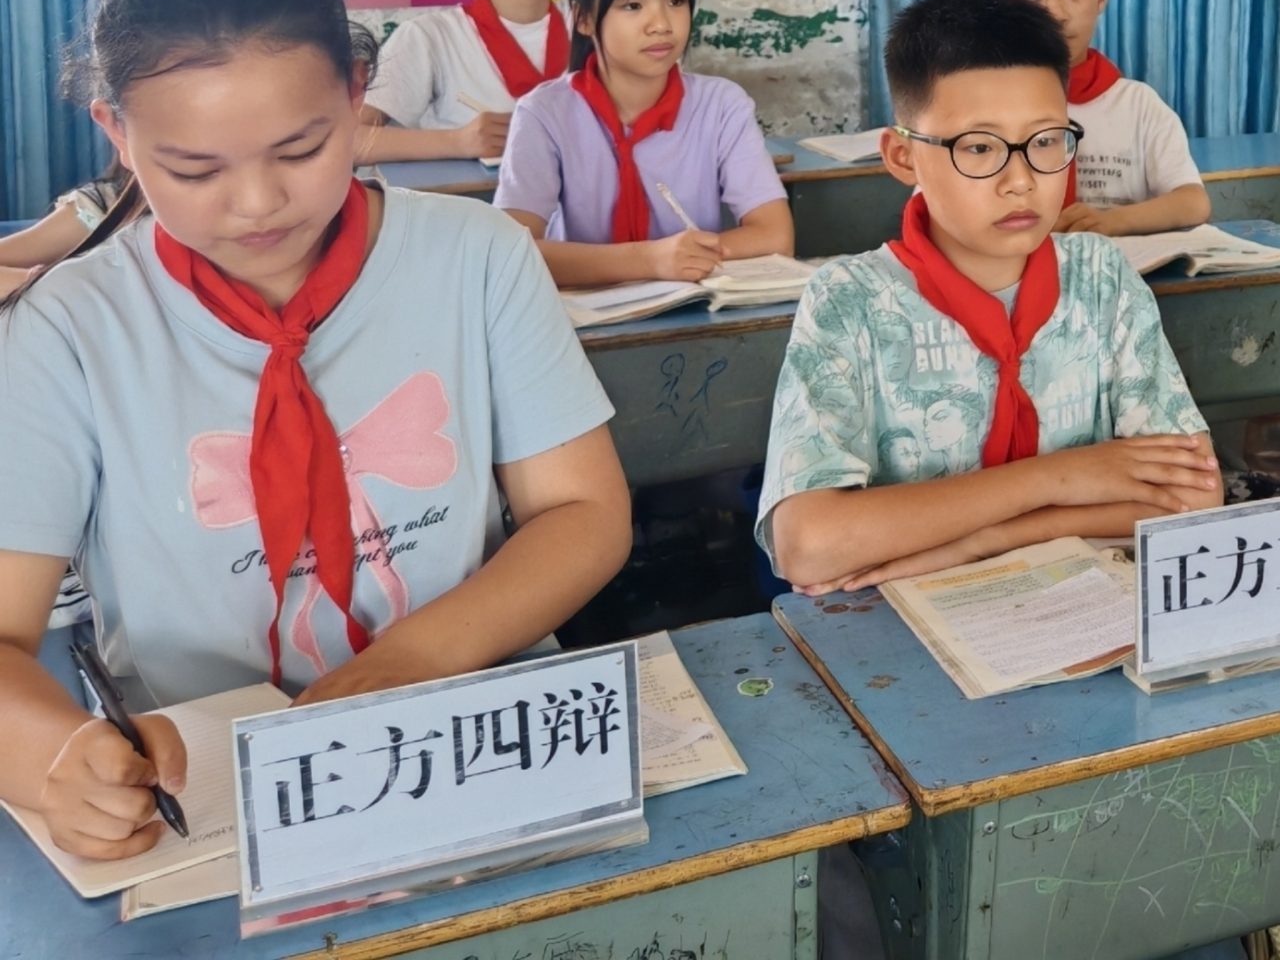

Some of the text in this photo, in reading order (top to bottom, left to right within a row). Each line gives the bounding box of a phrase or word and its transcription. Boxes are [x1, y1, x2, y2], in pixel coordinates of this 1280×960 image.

[404, 505, 450, 533] what
[262, 682, 622, 833] 正方四辩
